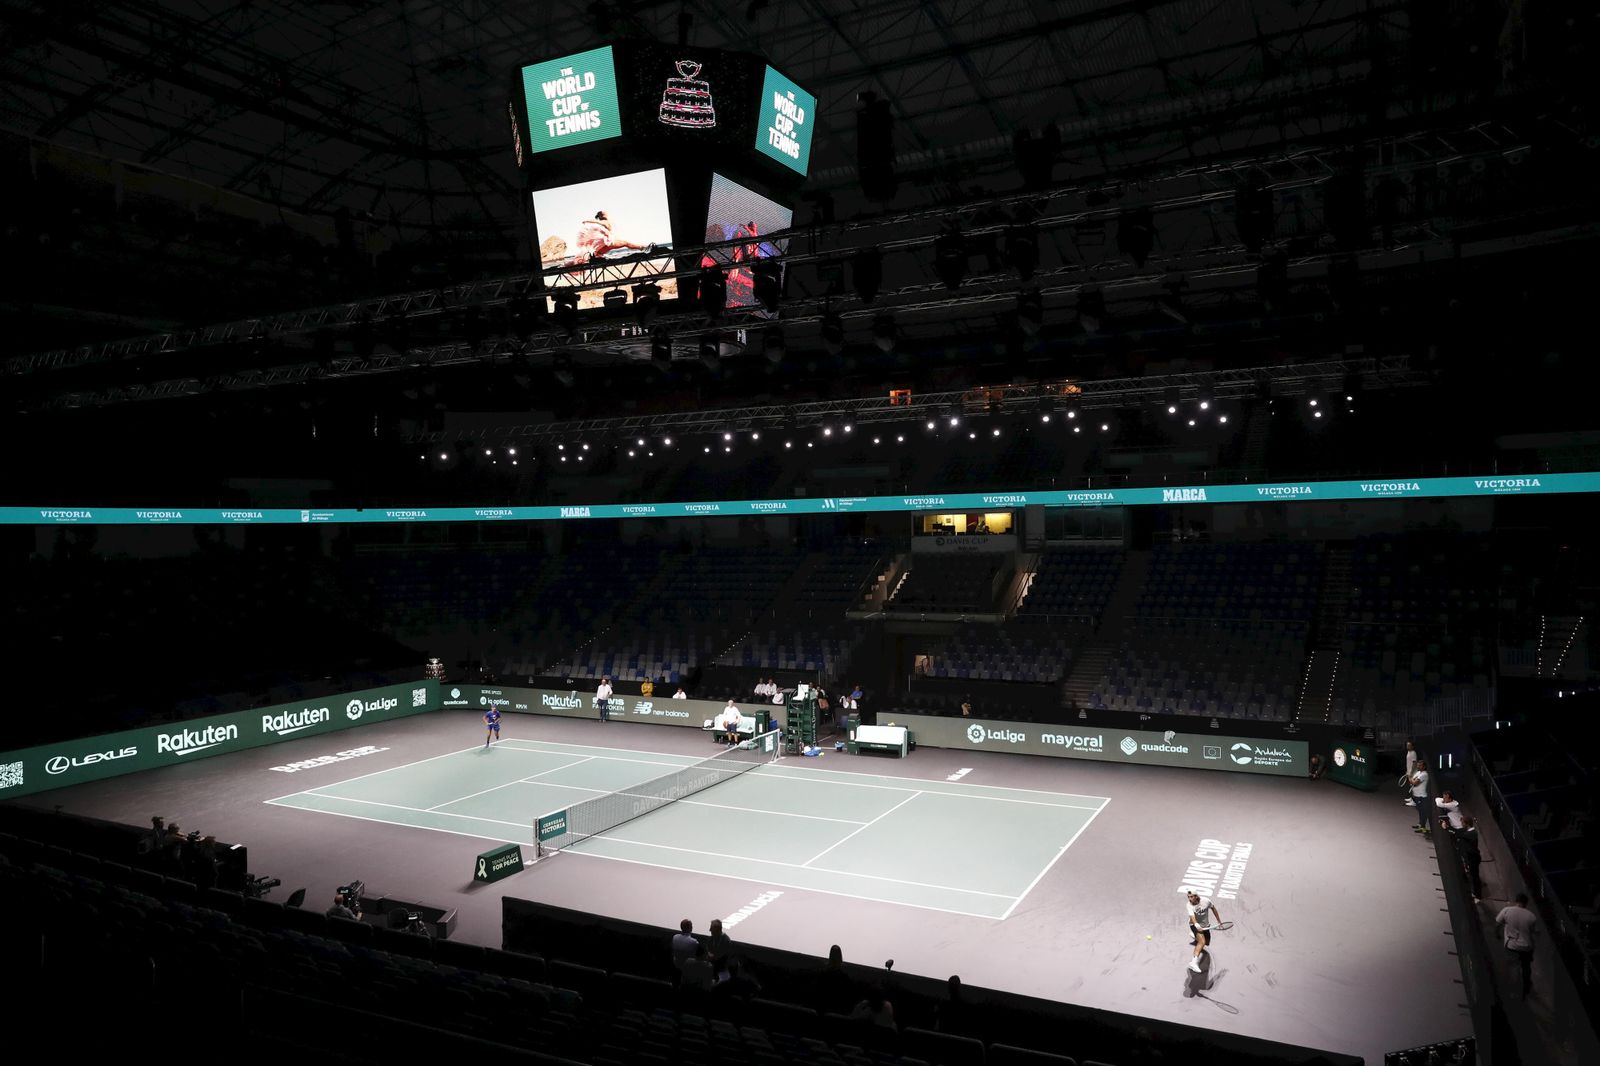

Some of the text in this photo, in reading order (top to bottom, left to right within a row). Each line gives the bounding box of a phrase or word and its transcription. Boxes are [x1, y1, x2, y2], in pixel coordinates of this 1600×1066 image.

[560, 67, 573, 77] THE
[541, 71, 596, 100] WORLD
[552, 94, 582, 117] CUP
[774, 91, 805, 125] WORLD
[545, 110, 601, 138] TENNIS
[775, 112, 794, 136] CUP
[768, 126, 800, 160] TENNIS
[1257, 486, 1312, 495] VICTORIA
[1360, 483, 1421, 492] VICTORIA
[1474, 478, 1541, 489] VICTORIA
[903, 497, 945, 505] VICTORIA
[983, 495, 1027, 503] VICTORIA
[1067, 492, 1114, 500] VICTORIA
[1163, 488, 1207, 502] MARCA
[40, 510, 92, 518] VICTORIA
[560, 507, 591, 518] MARCA
[946, 537, 989, 545] DAVIS CUP
[365, 697, 398, 712] LaLiga
[493, 698, 510, 706] option
[542, 694, 582, 708] Rakuten
[262, 707, 330, 733] Rakuten
[653, 708, 690, 718] new balance
[157, 724, 238, 753] Rakuten
[987, 729, 1026, 744] LaLiga
[1041, 733, 1103, 749] mayoral
[1141, 743, 1189, 754] quadcode
[71, 746, 138, 767] LEXUS
[1351, 754, 1366, 764] ROLEX
[541, 821, 566, 835] VICTORIA
[492, 856, 519, 871] FOR PEACE
[1176, 838, 1232, 897] DAVIS CUP
